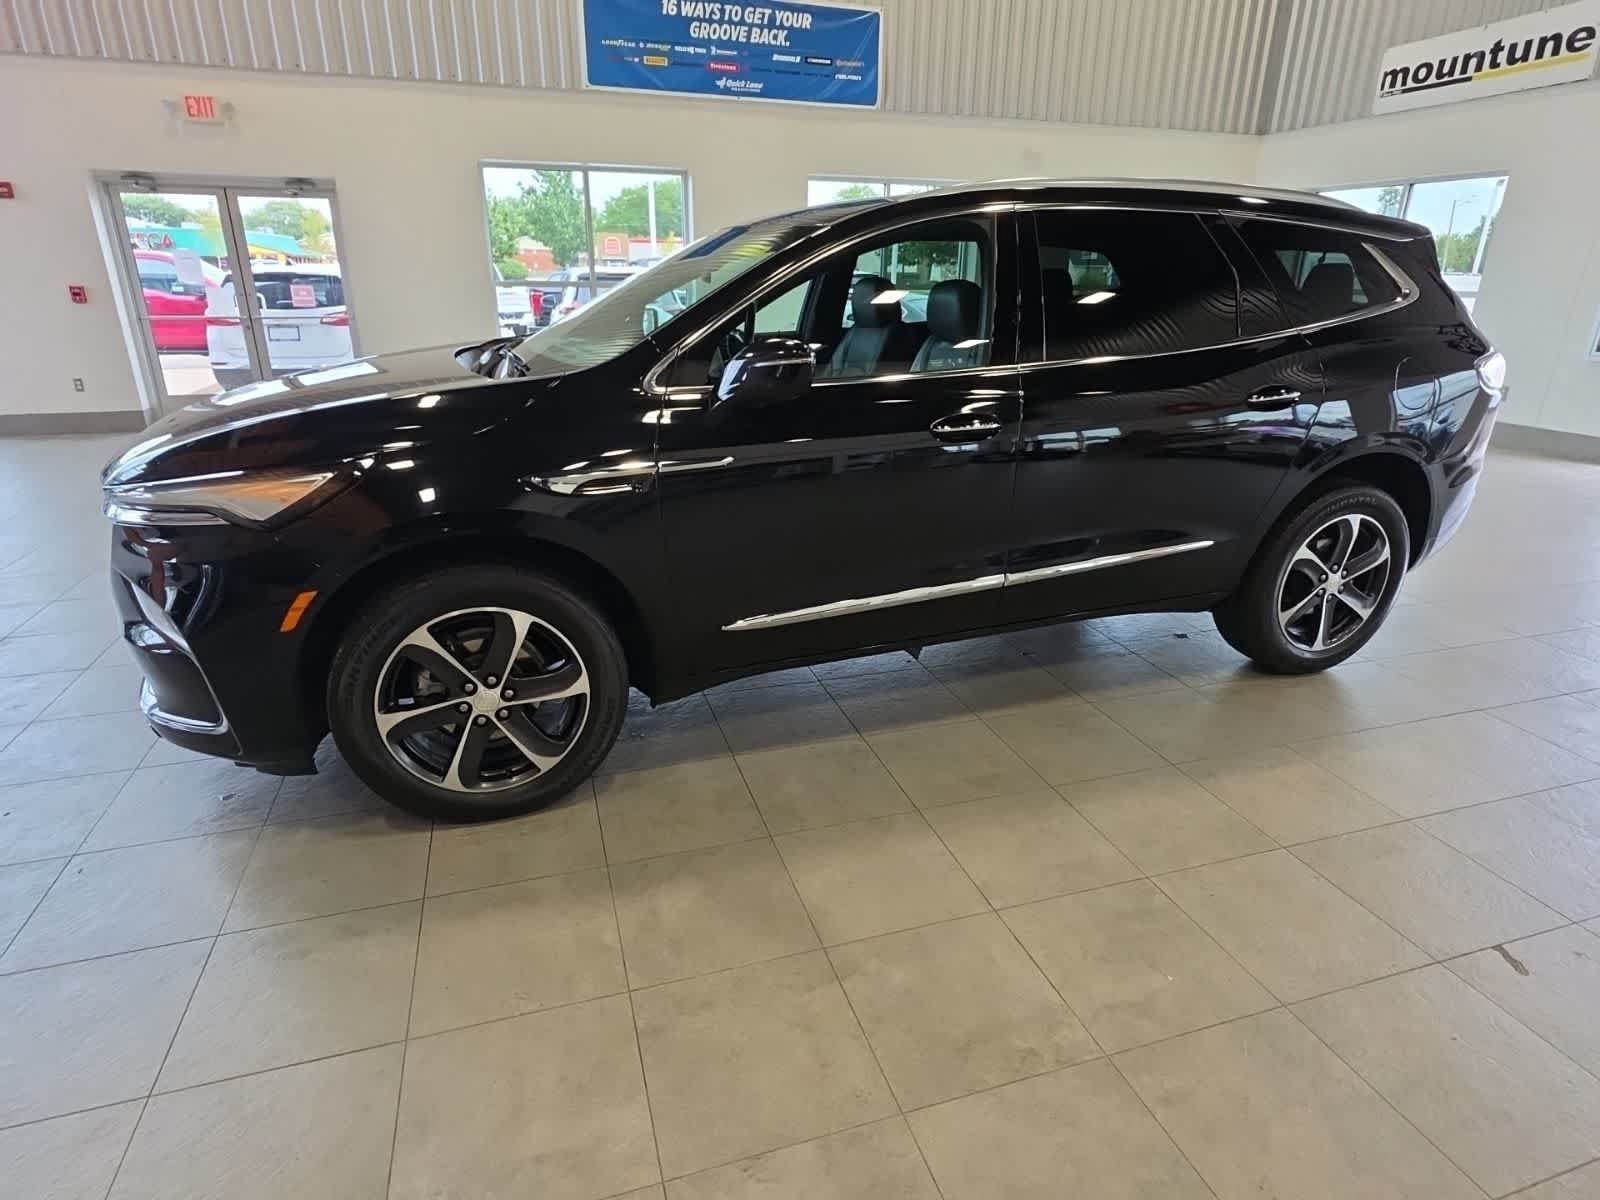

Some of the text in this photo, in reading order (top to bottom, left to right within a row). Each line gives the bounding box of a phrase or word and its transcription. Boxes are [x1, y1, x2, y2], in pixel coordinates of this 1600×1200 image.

[662, 0, 812, 29] 16 WAYS TO GET YOUR
[689, 21, 790, 47] GROOVE BACK.
[1380, 25, 1597, 91] mountune
[184, 95, 215, 119] EXIT
